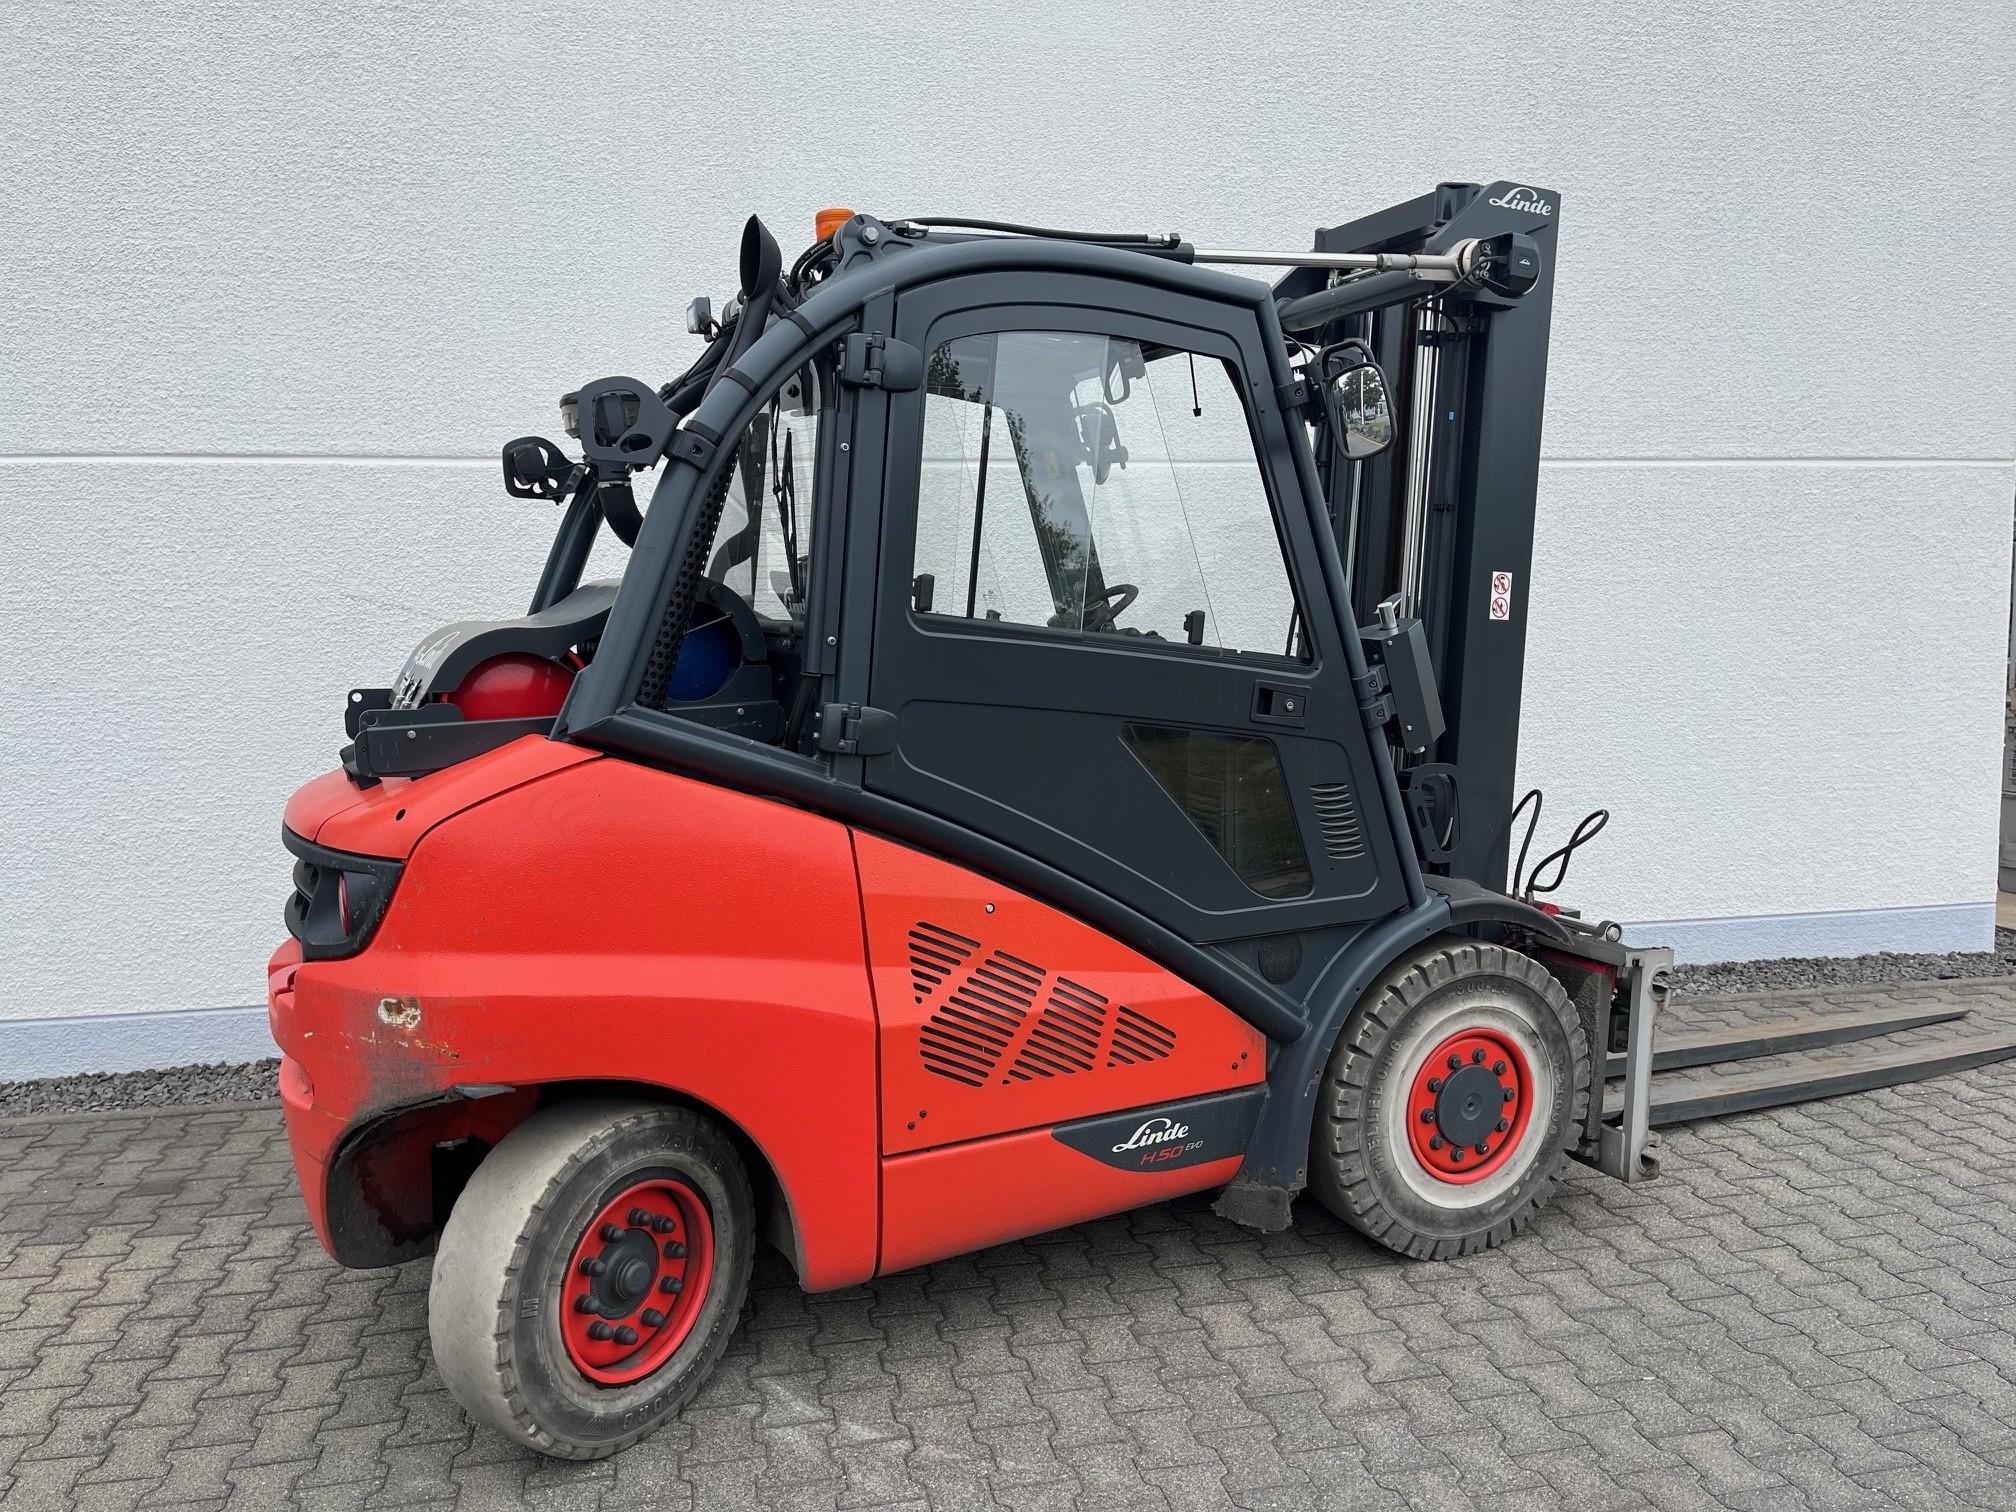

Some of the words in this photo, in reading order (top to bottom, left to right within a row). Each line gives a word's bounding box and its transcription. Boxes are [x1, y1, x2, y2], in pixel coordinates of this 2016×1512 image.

[1489, 187, 1551, 216] Linde
[1367, 1039, 1402, 1179] TRELLEBORG
[1112, 1118, 1189, 1152] Linde
